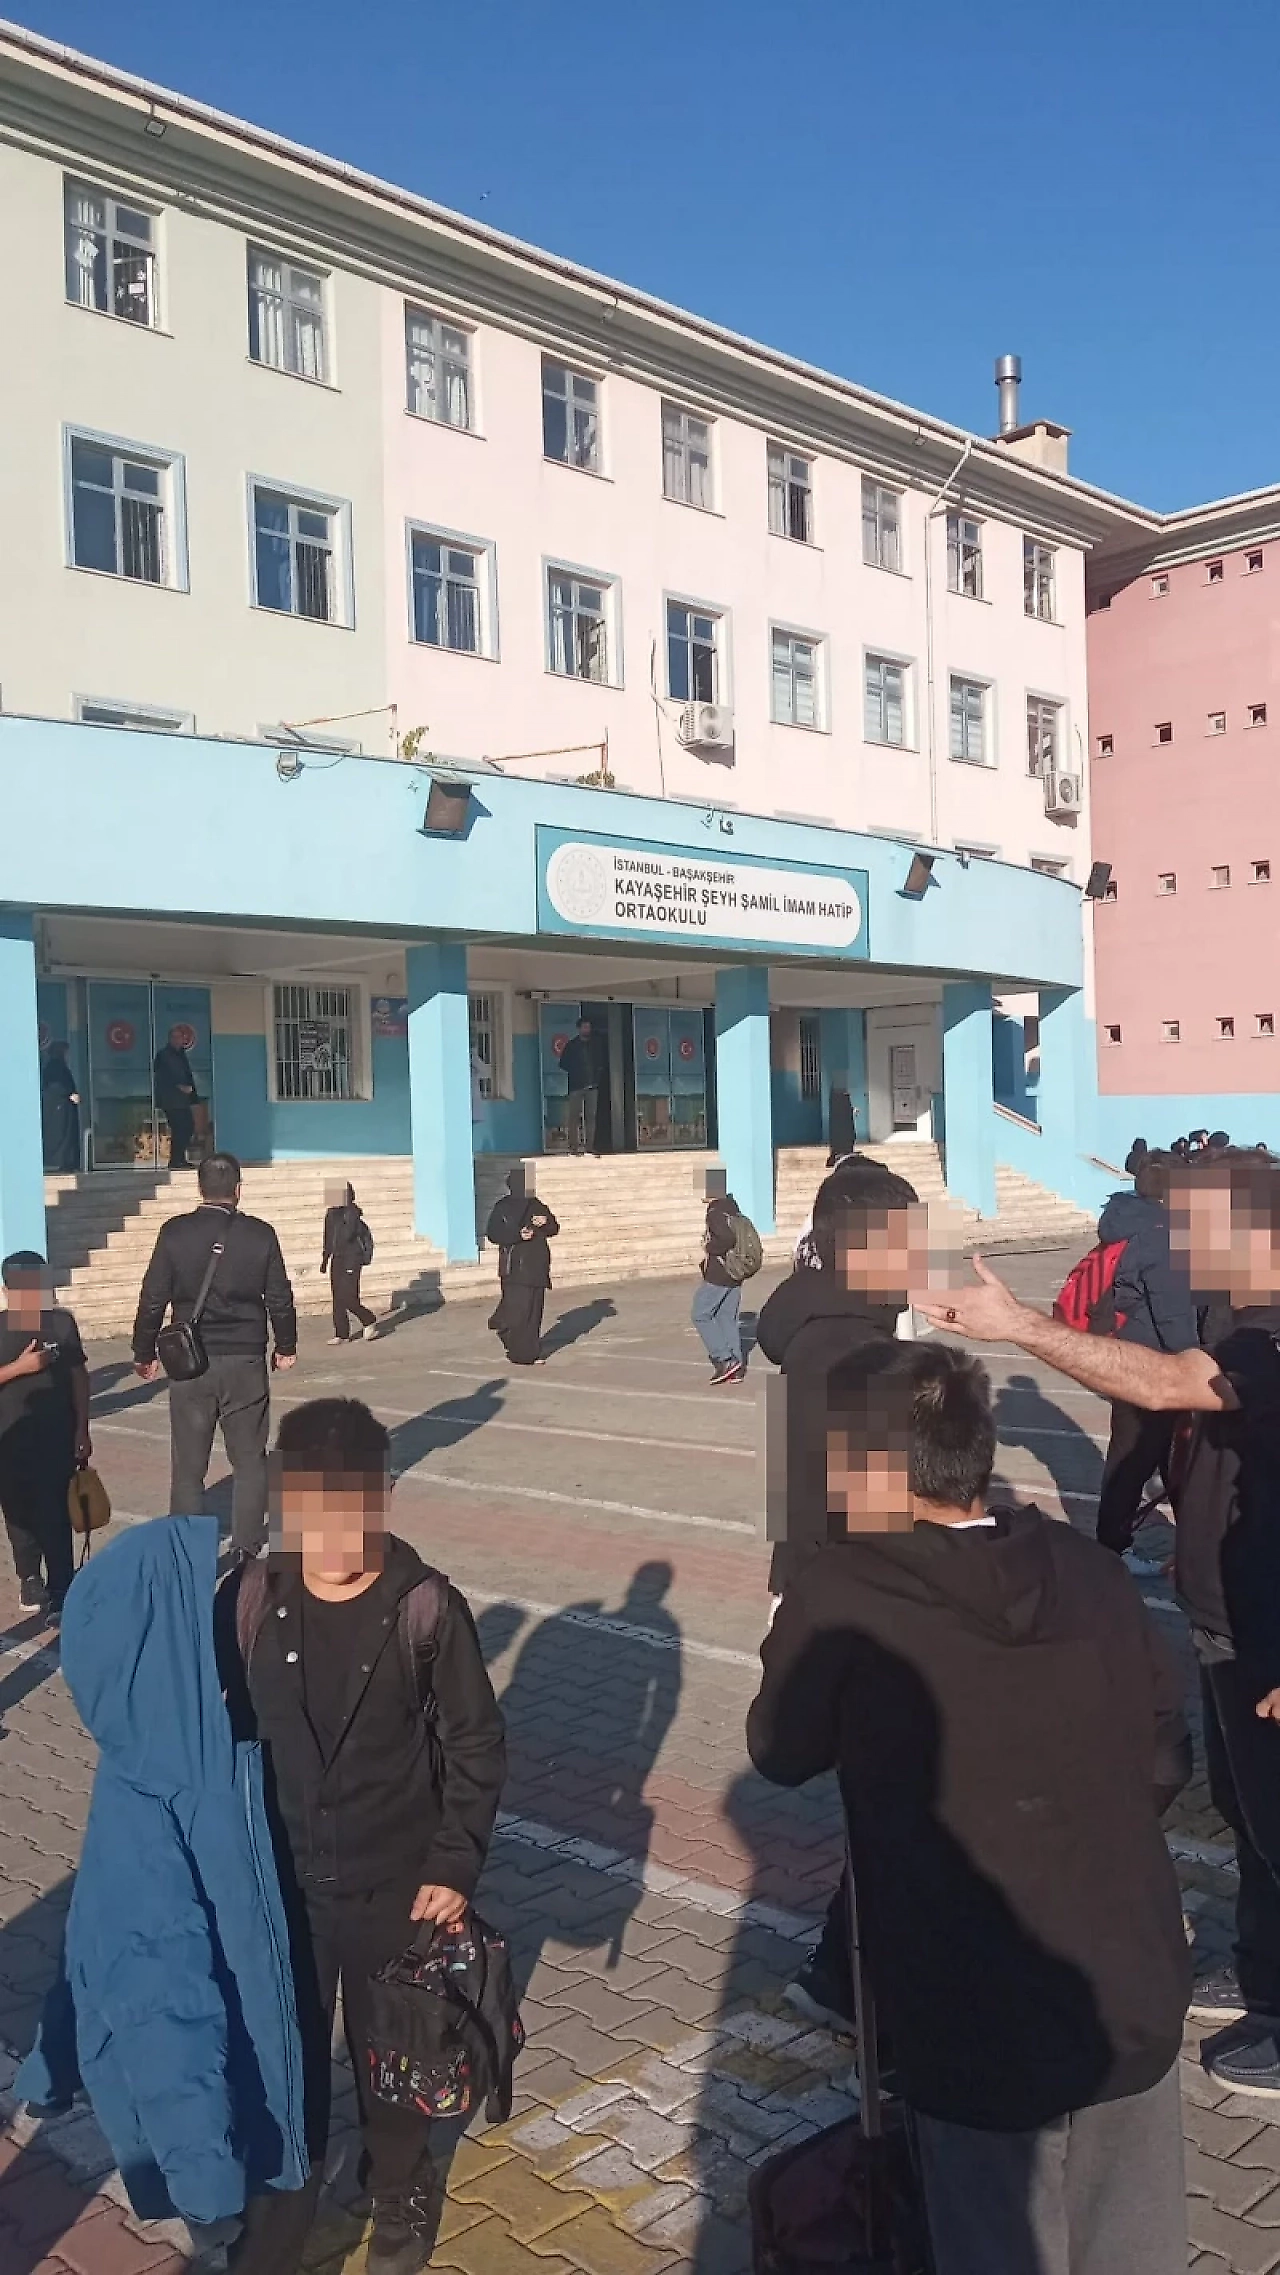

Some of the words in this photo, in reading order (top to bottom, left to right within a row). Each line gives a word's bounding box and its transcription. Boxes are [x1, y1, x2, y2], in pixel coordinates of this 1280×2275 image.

[613, 855, 665, 876] İSTANBUL
[673, 866, 735, 886] BAŞAKŞEHİR
[615, 878, 698, 903] KAYAŞEHİR
[701, 889, 737, 908] ŞEYH
[741, 893, 780, 913] ŞAMİL
[783, 894, 816, 916] İMAM
[818, 901, 854, 919] HATİP
[615, 901, 708, 926] ORTAOKULU
